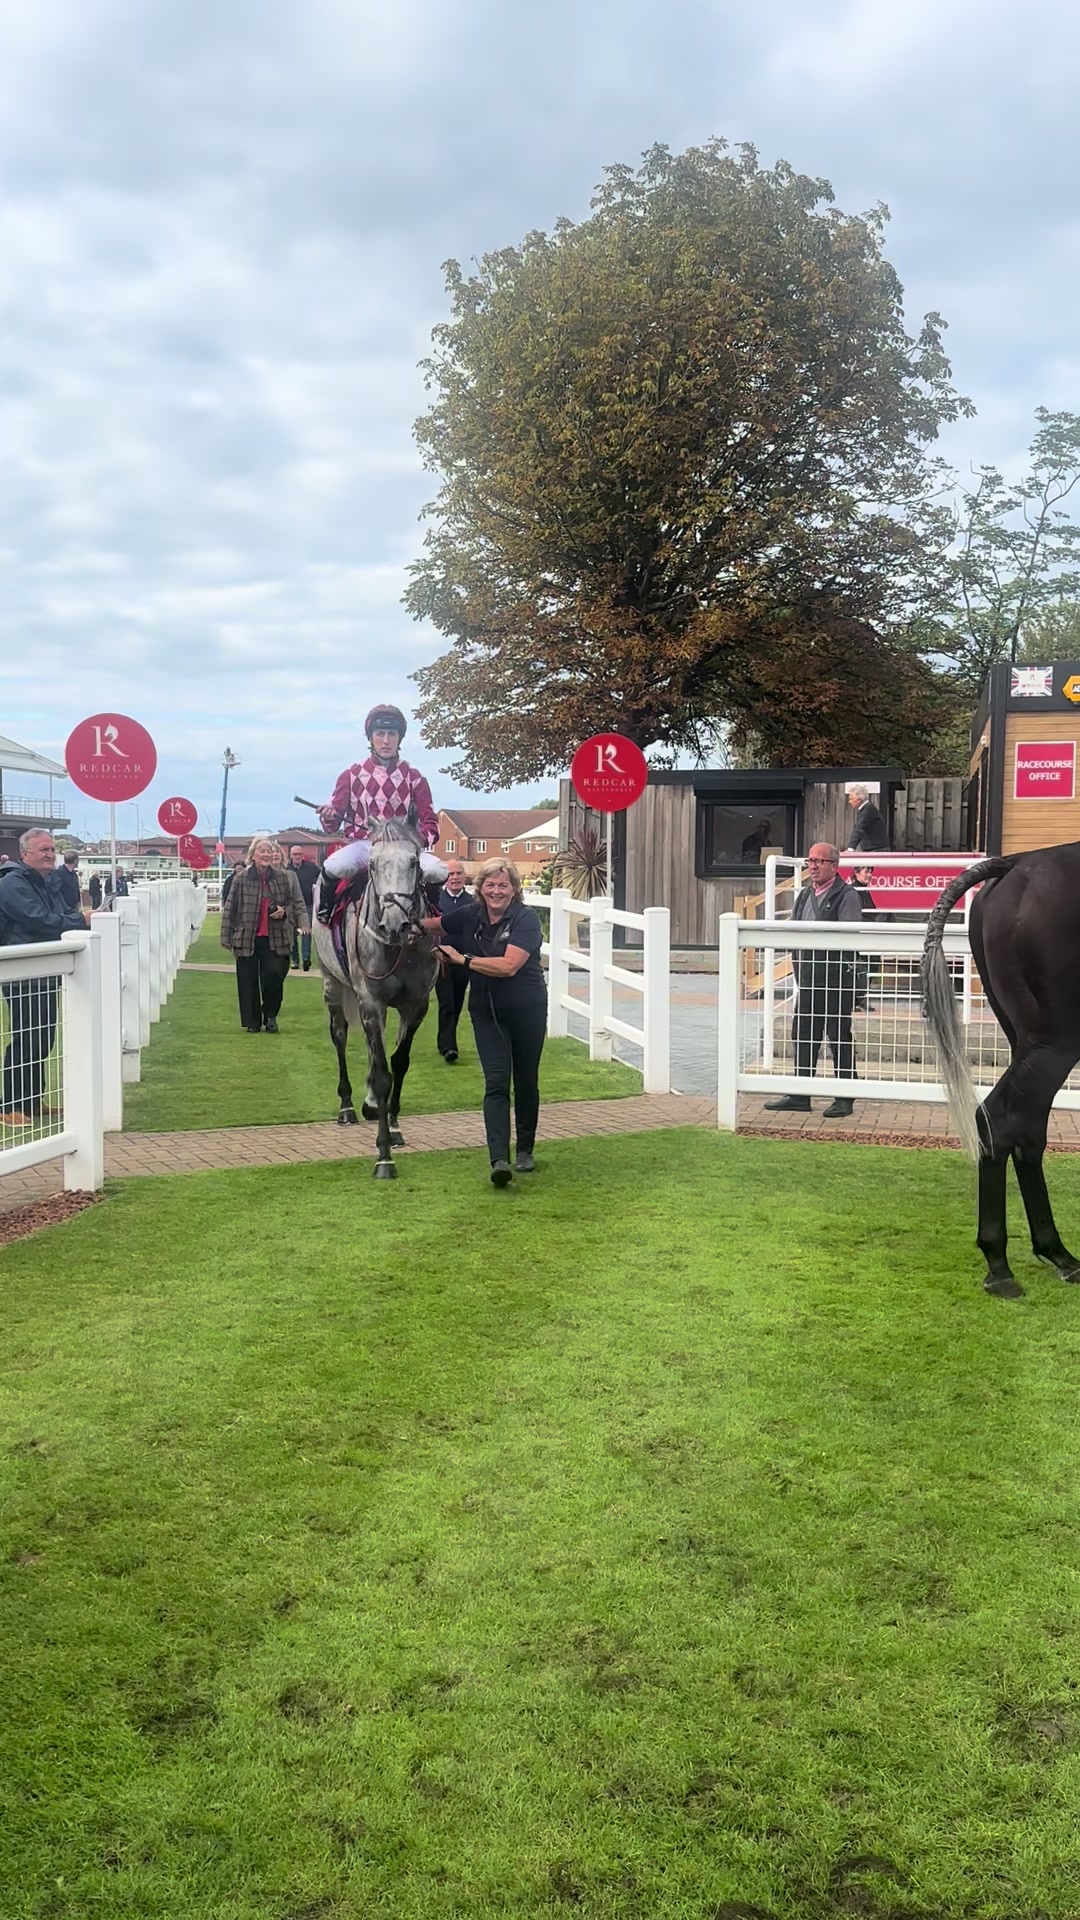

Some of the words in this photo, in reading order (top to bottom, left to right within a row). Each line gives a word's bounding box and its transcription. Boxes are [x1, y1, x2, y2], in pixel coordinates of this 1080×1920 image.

[80, 763, 143, 774] REDCAR
[1017, 760, 1073, 769] RACECOURSE
[1029, 772, 1061, 781] OFFICE
[583, 778, 636, 787] REDCAR
